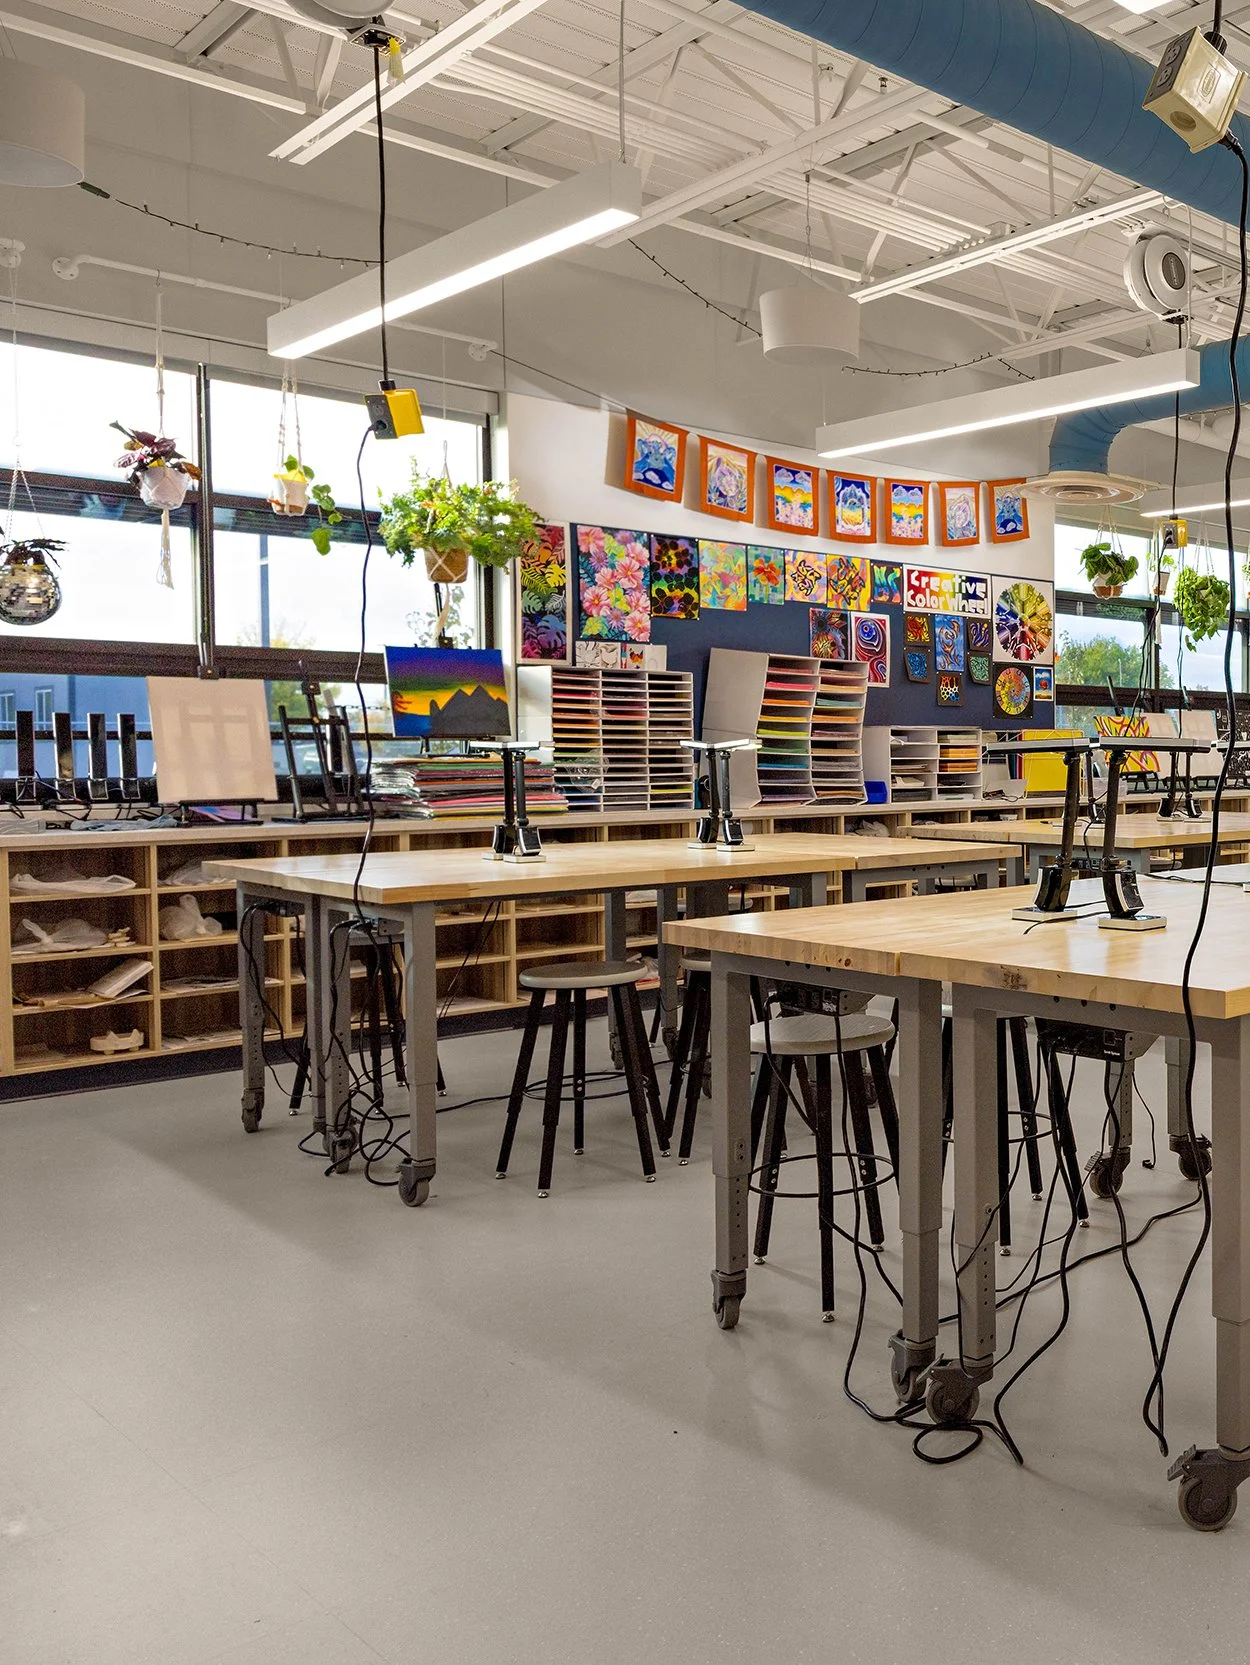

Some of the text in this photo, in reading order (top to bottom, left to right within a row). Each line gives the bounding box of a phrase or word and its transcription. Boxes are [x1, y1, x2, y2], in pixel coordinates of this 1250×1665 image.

[910, 570, 986, 598] Creative
[907, 588, 988, 614] Color Wheel
